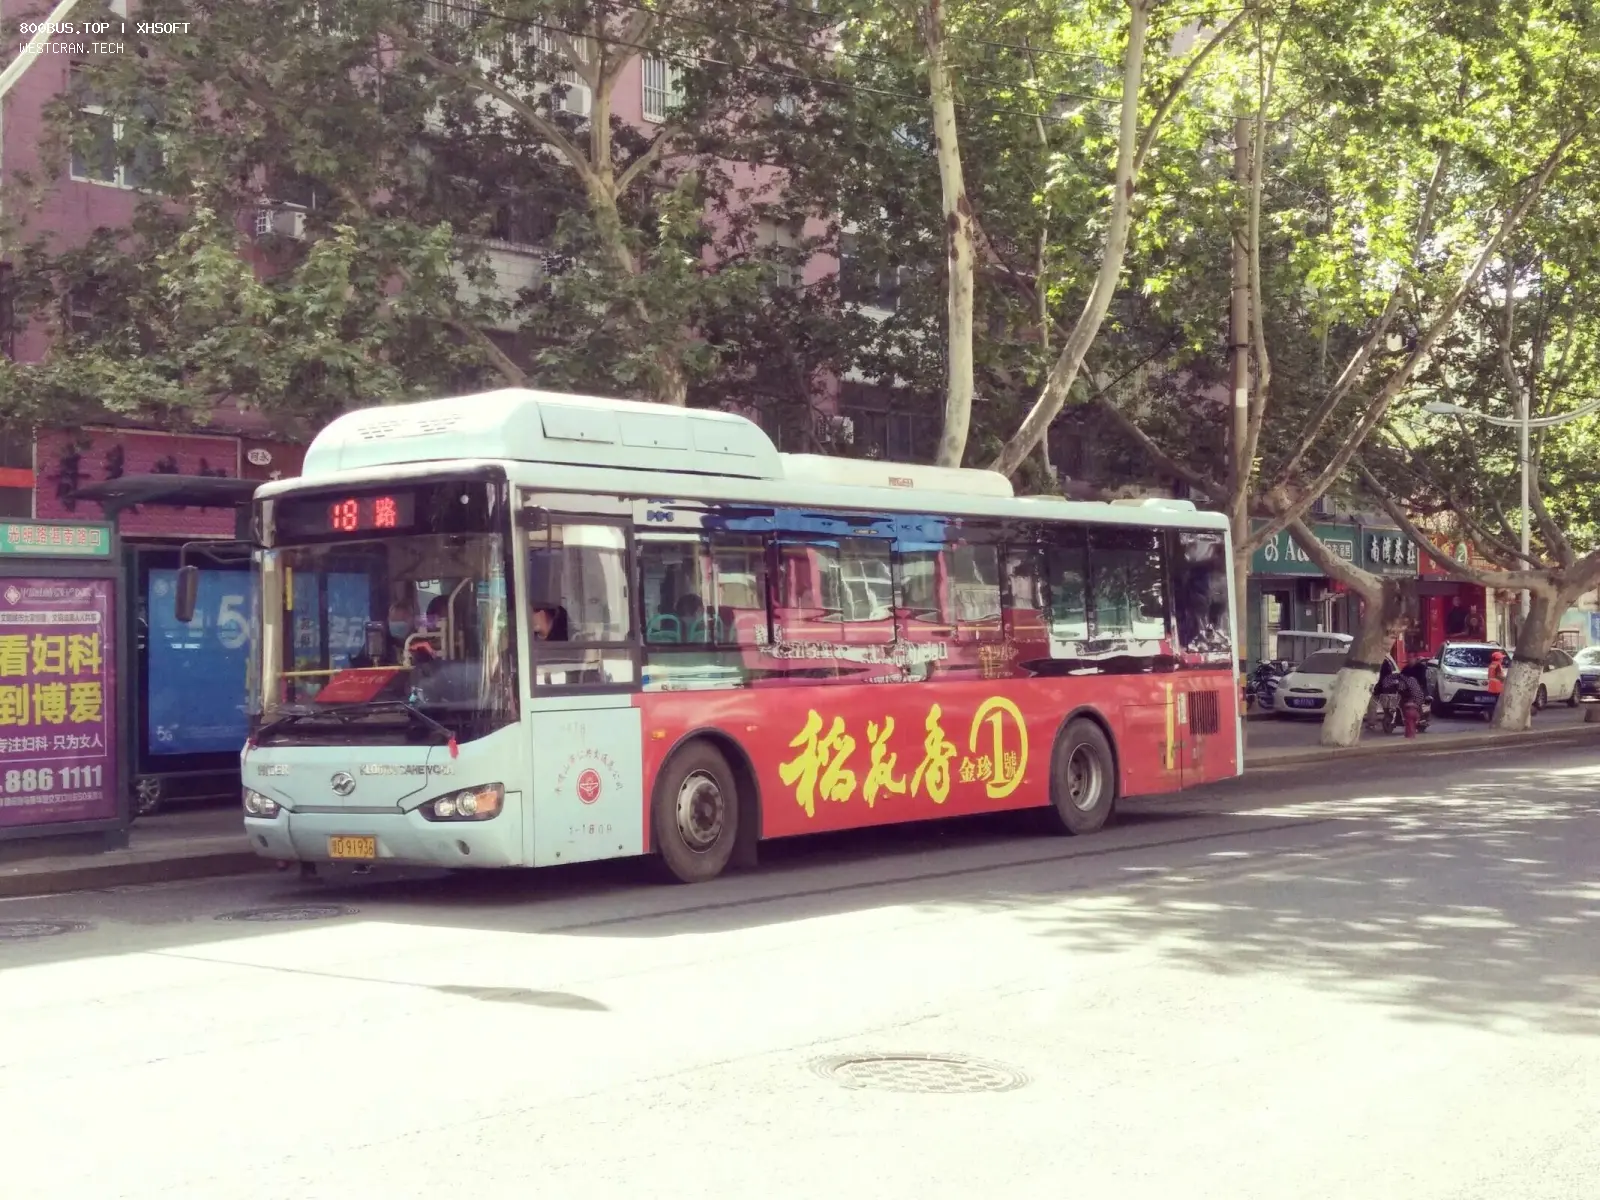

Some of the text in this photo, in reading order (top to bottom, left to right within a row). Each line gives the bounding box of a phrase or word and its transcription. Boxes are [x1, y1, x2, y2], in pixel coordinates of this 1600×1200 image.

[333, 496, 396, 532] 18 路
[0, 632, 102, 676] 看妇科
[0, 681, 103, 726] 到博爱
[5, 764, 103, 793] 886 1111
